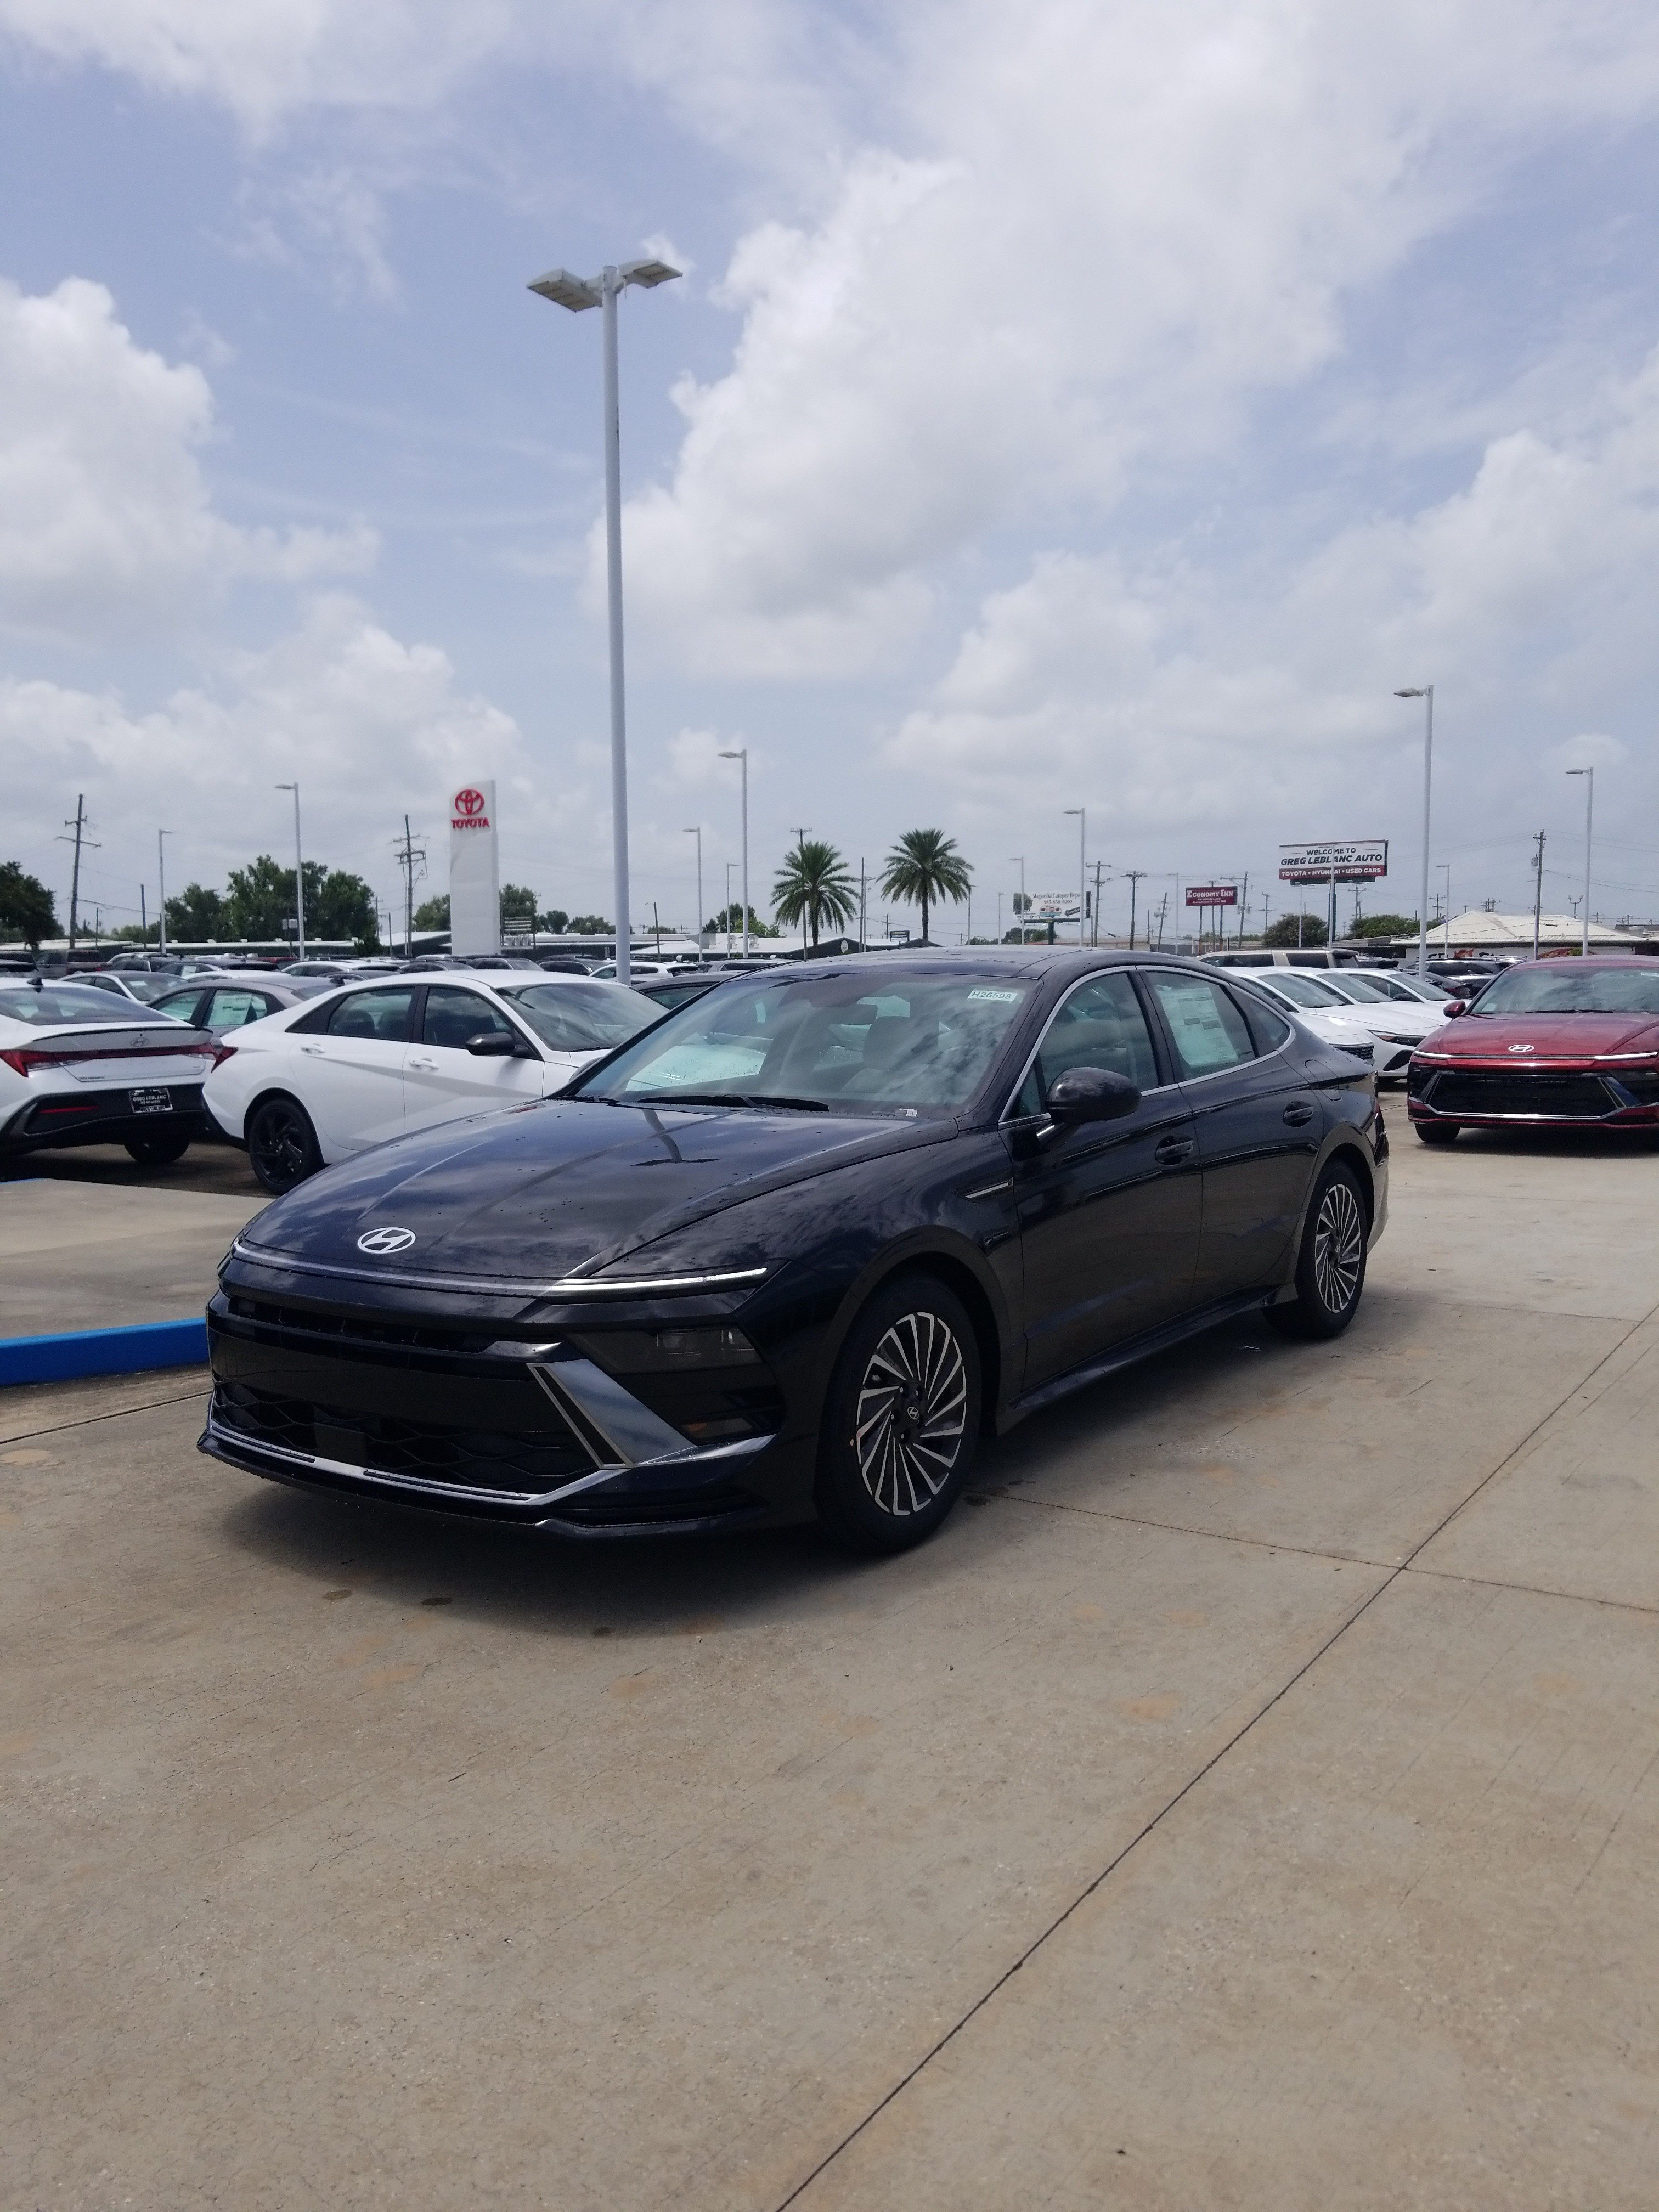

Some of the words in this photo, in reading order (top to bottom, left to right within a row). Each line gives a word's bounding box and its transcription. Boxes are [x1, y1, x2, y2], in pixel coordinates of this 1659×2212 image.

[451, 817, 490, 829] TOYOTA
[1280, 857, 1306, 865] GREG
[1308, 855, 1353, 864] LEBLANC
[1355, 854, 1383, 862] AUTO
